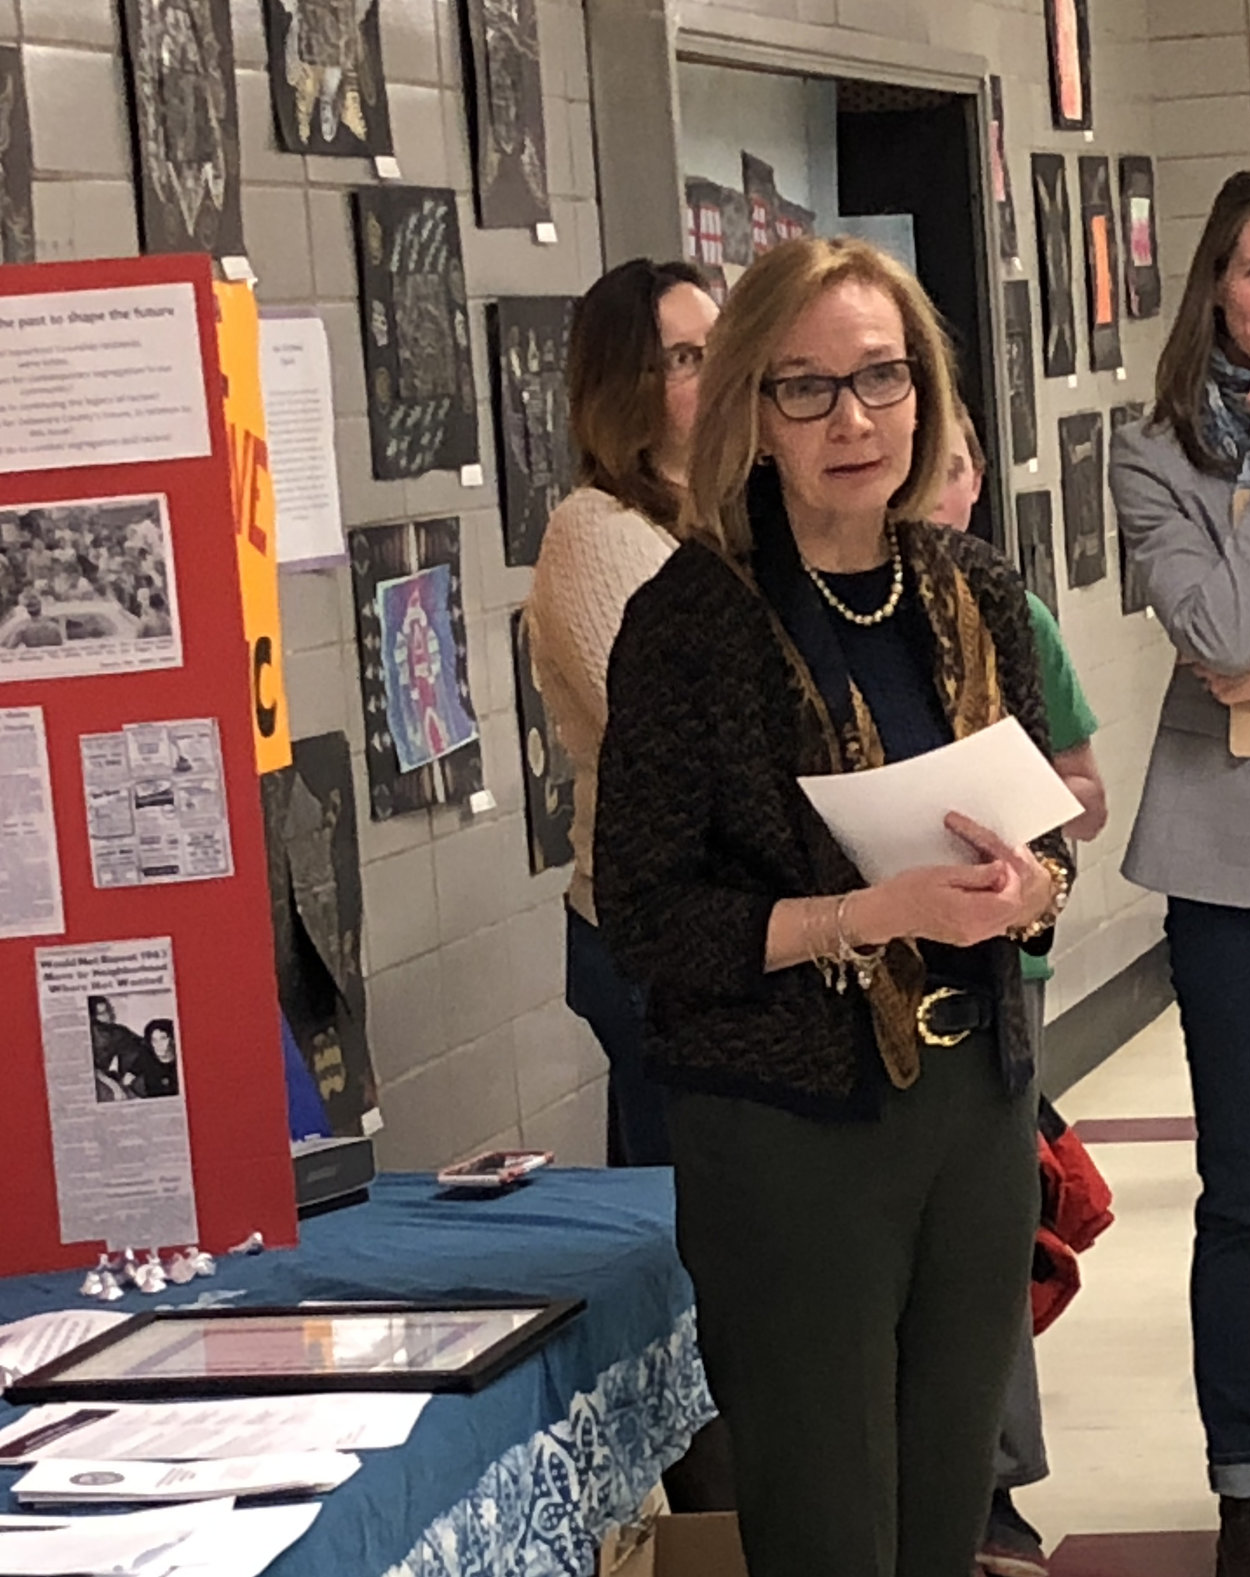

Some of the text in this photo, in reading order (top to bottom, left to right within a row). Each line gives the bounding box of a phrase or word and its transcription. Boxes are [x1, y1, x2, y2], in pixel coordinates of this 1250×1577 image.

[18, 315, 46, 329] past
[50, 314, 63, 325] to
[68, 310, 105, 325] shape
[109, 308, 130, 320] the
[133, 306, 175, 319] future
[41, 957, 77, 969] Would
[78, 955, 99, 966] Not
[101, 953, 138, 964] Repeat
[43, 972, 73, 981] Move
[76, 970, 89, 980] to
[48, 974, 164, 993] Where Not Wanted
